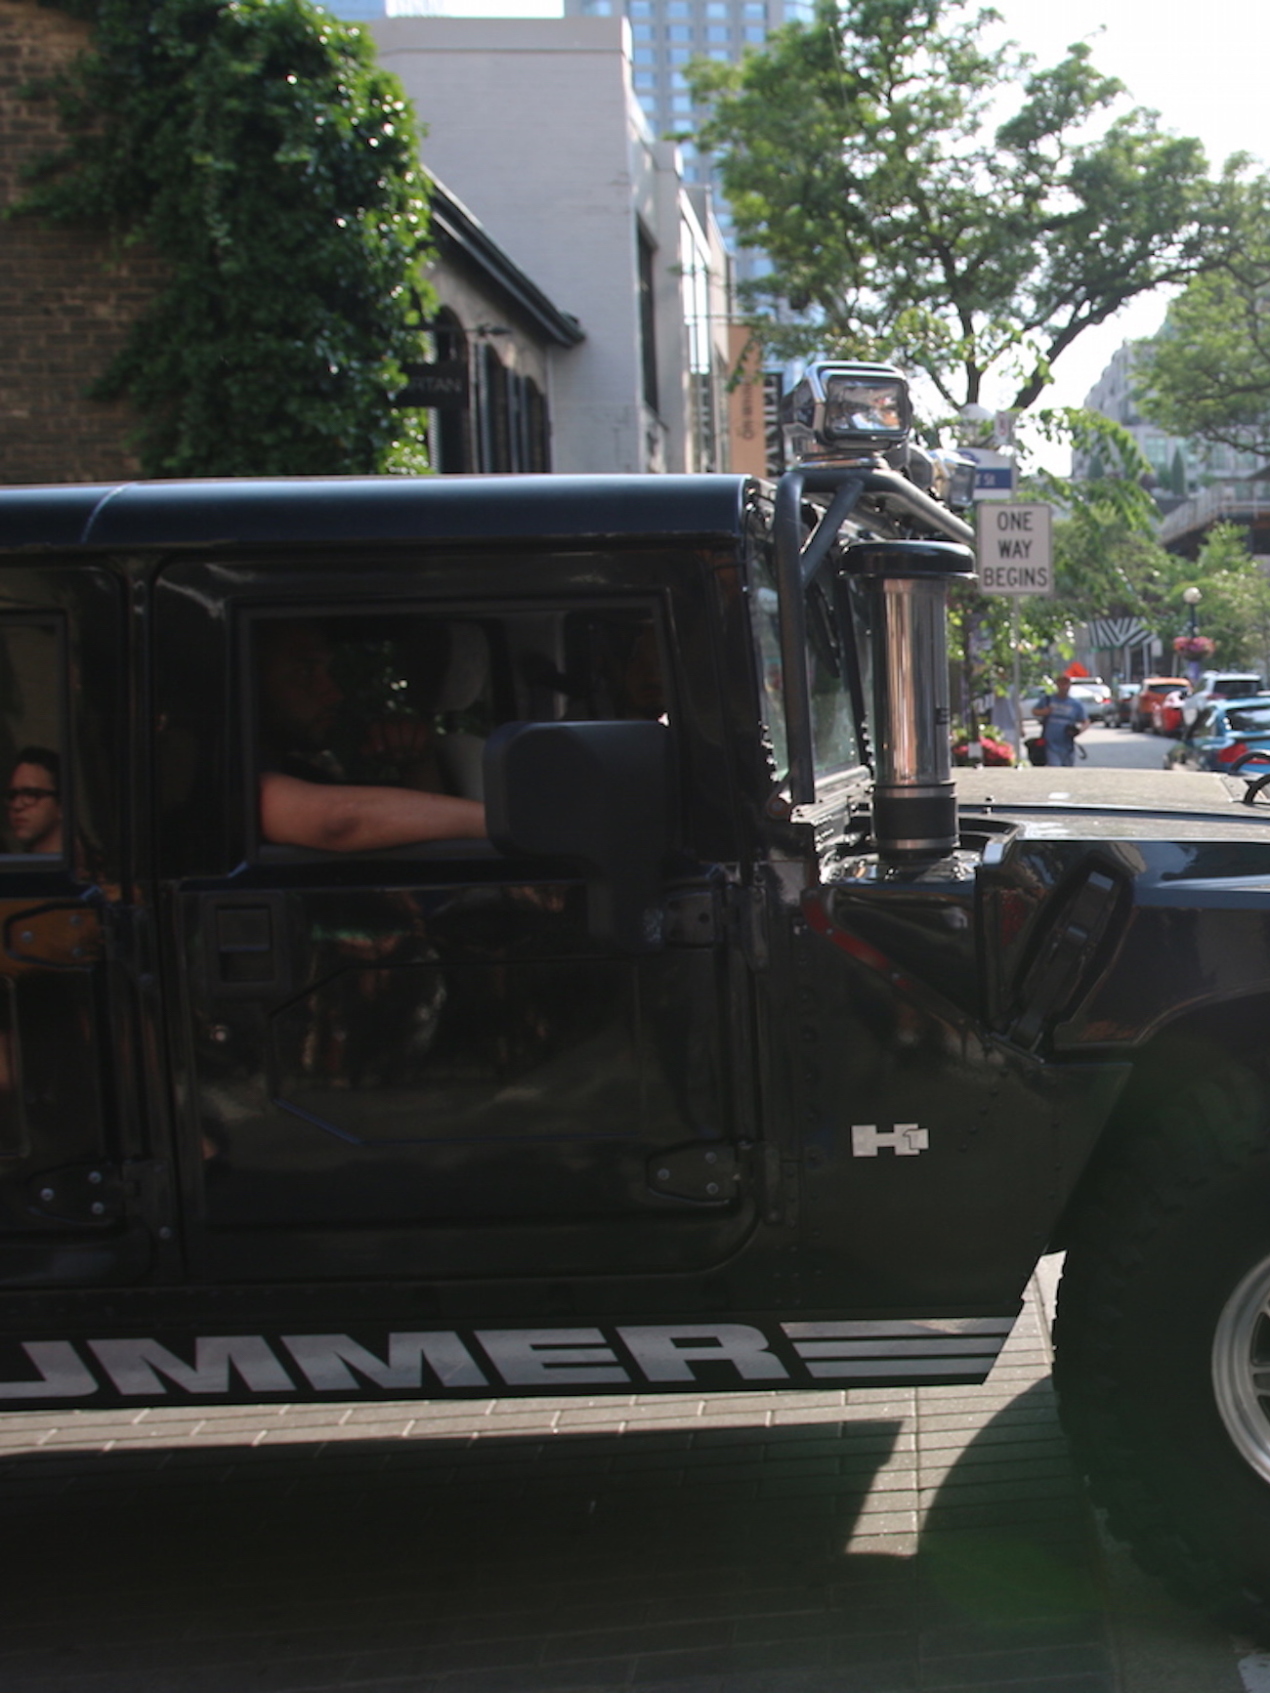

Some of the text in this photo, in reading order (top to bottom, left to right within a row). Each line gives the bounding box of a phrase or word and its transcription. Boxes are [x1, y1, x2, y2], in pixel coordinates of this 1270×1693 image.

[997, 511, 1033, 531] ONE
[998, 540, 1032, 559] WAY
[984, 566, 1049, 588] BEGINS
